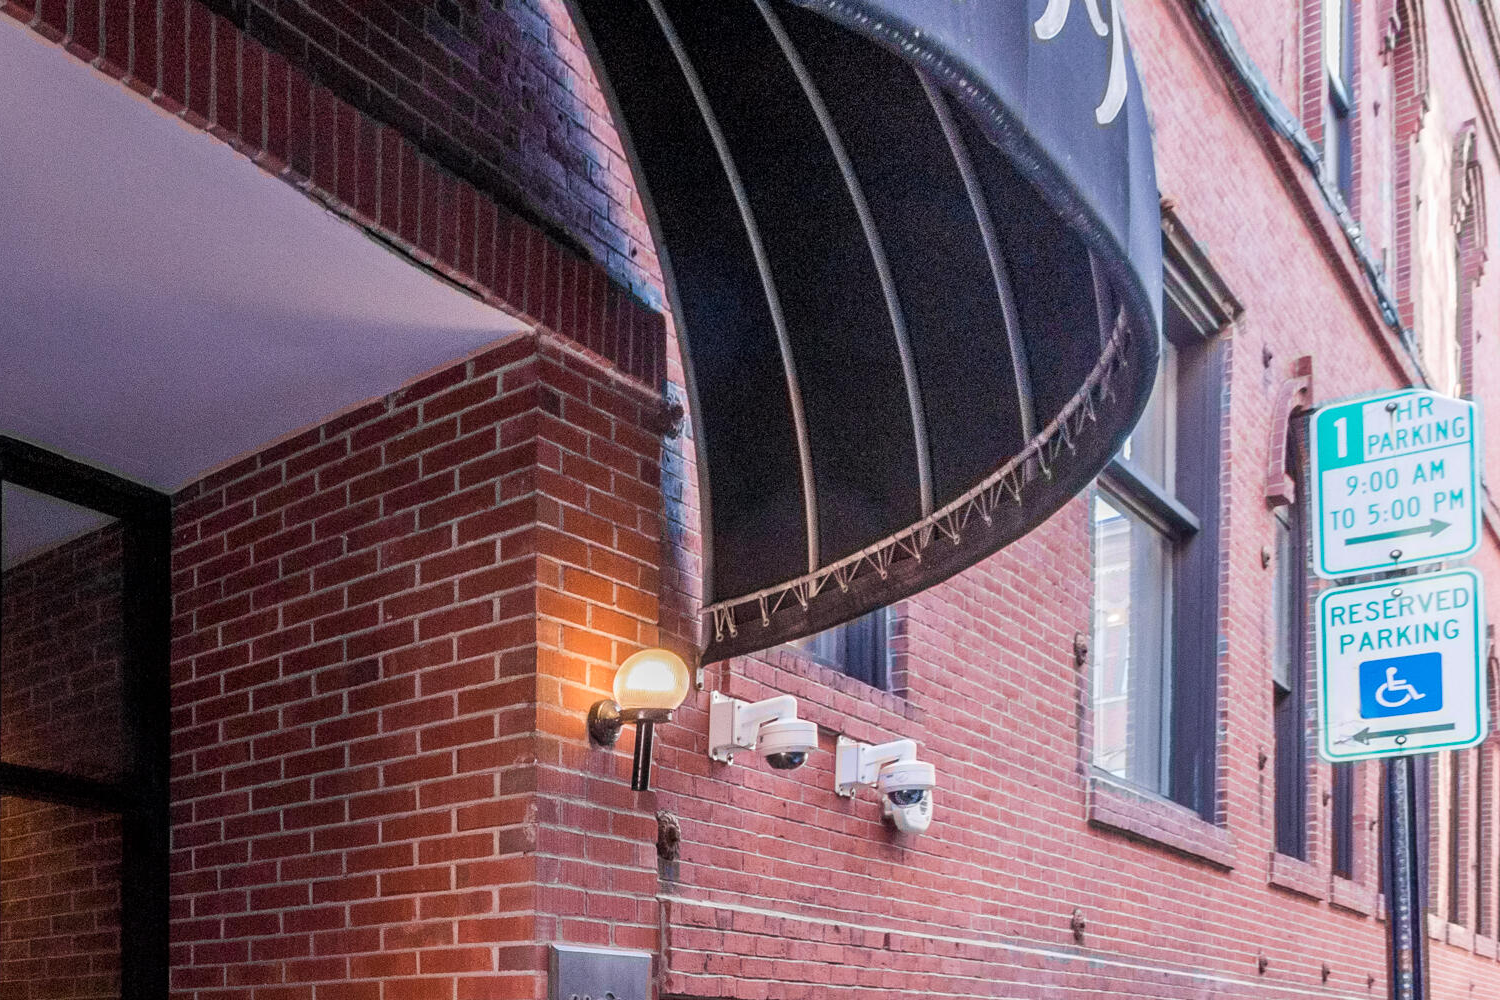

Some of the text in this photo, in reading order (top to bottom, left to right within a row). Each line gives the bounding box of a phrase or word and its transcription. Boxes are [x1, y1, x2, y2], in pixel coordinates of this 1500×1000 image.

[1333, 396, 1434, 459] 1 HR
[1367, 416, 1466, 456] PARKING
[1346, 458, 1445, 497] 9:00 AM
[1329, 488, 1464, 531] TO 5:00 PM
[1331, 587, 1470, 627] RESERVED
[1340, 618, 1460, 655] PARKING
